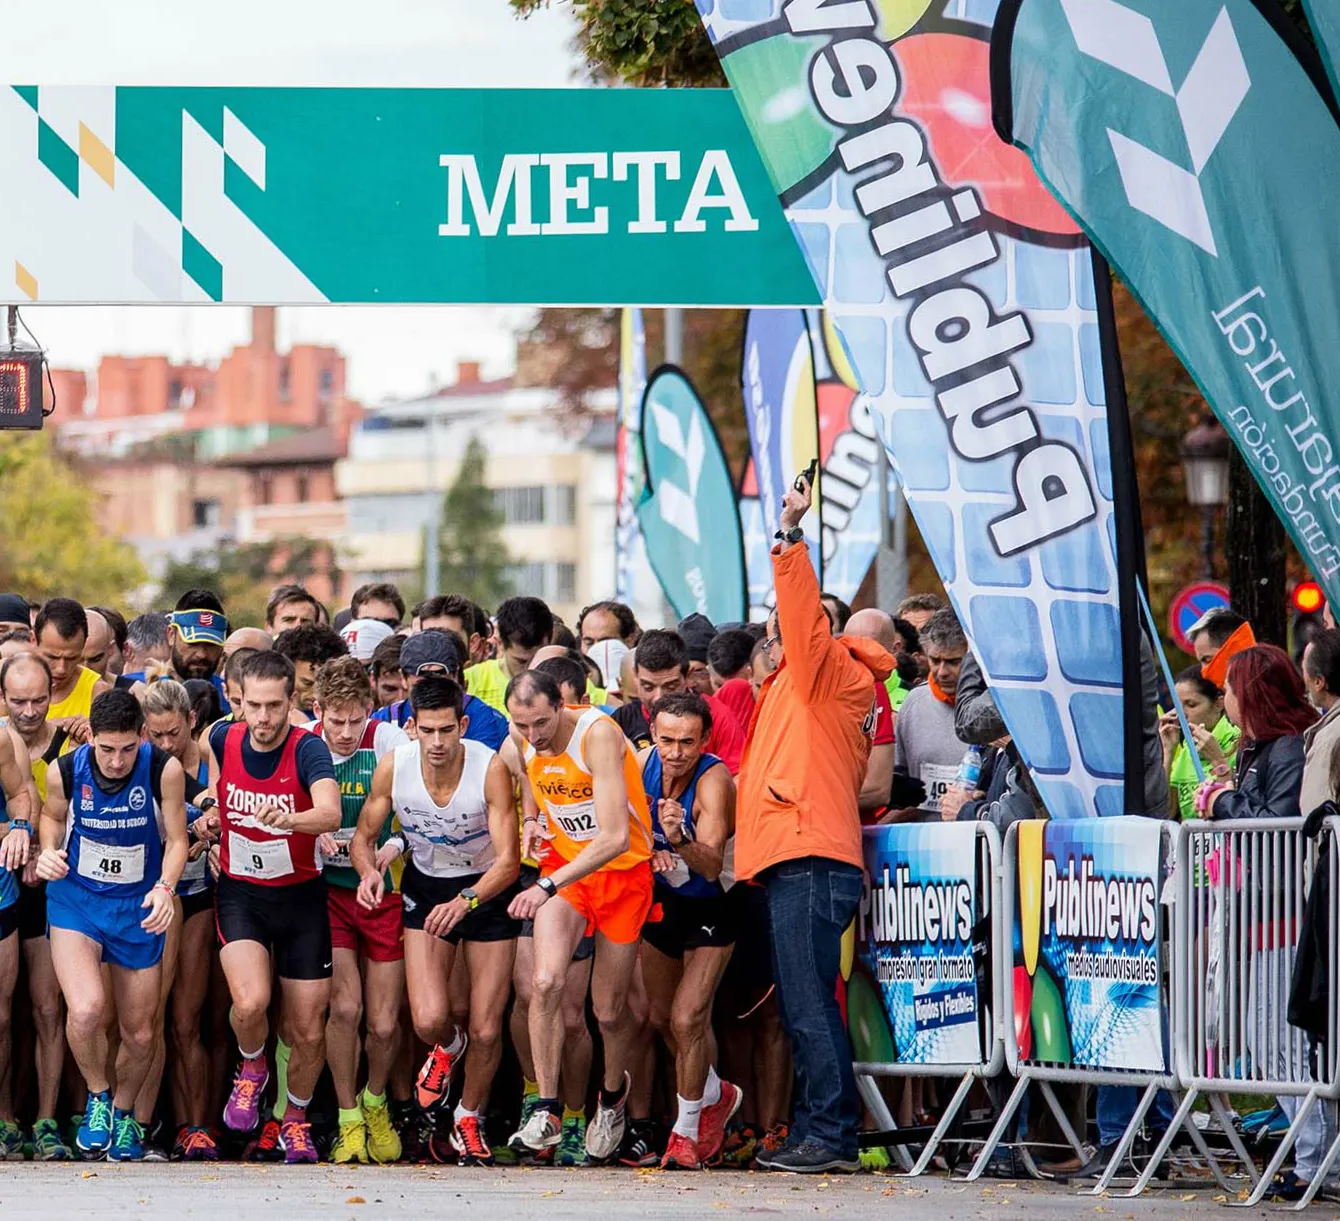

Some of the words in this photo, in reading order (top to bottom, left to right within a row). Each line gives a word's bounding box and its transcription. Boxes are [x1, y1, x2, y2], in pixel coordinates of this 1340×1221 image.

[438, 149, 760, 237] META
[80, 816, 117, 829] UNIVERSIDAD
[117, 819, 126, 828] DE
[557, 814, 597, 832] 1012
[98, 858, 122, 874] 48
[251, 854, 264, 870] 9
[1044, 858, 1157, 942] Publinews
[877, 951, 918, 985] impresión
[919, 958, 939, 987] gran
[940, 951, 975, 983] formato
[1095, 947, 1158, 982] audiovisuales
